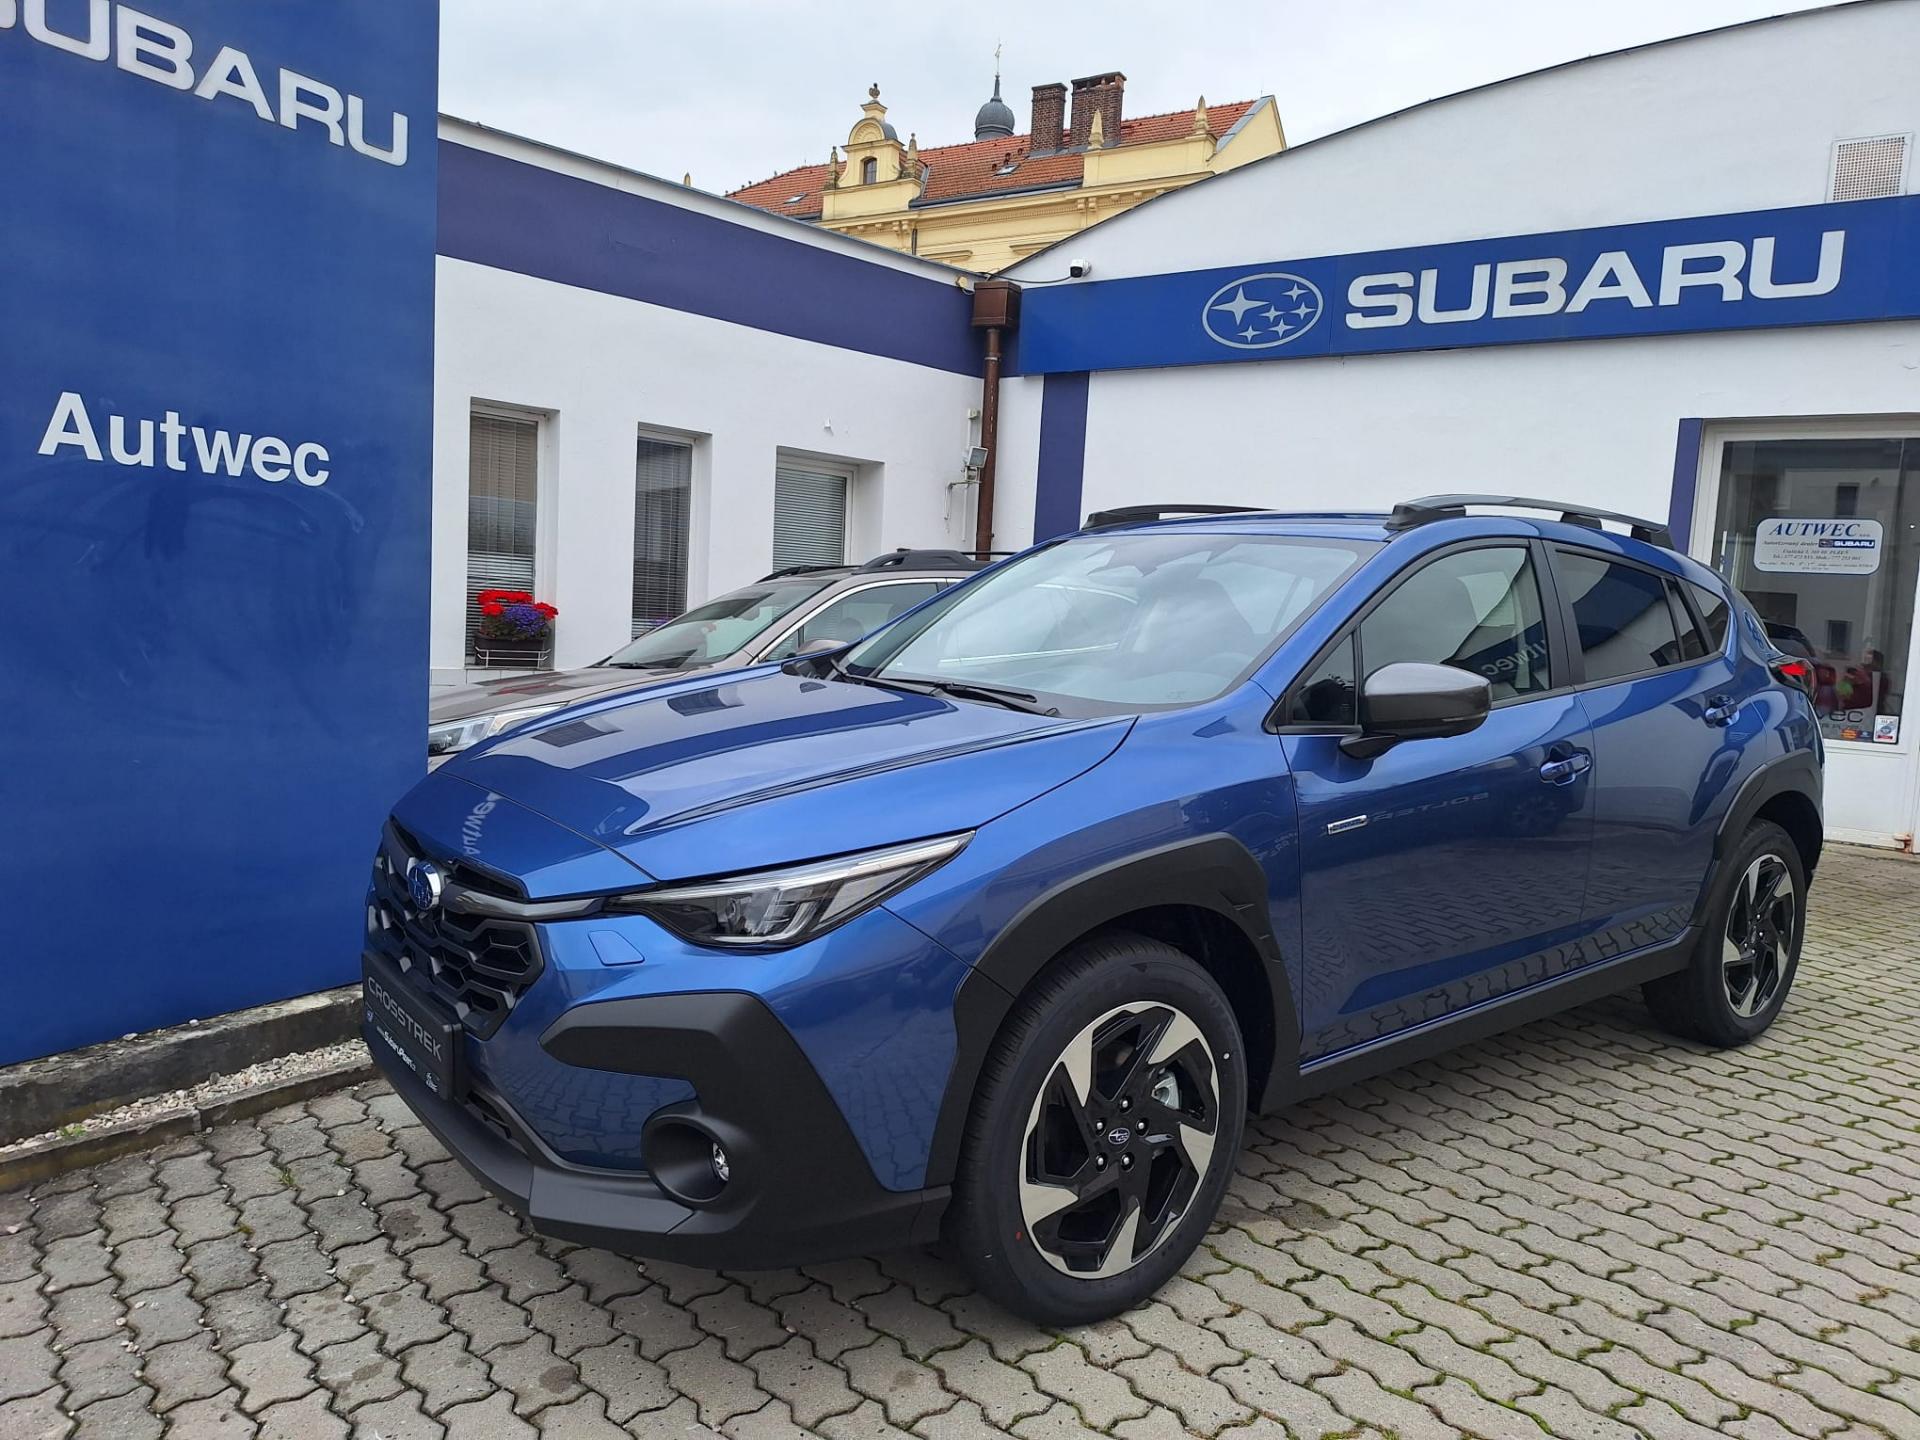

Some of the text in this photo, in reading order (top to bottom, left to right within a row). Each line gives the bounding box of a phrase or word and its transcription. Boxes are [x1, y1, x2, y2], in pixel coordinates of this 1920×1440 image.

[1345, 230, 1846, 331] SUBARU
[38, 391, 330, 486] Autwec
[1769, 522, 1861, 537] AUTWEC
[1833, 540, 1875, 548] SUBARU
[368, 976, 442, 1062] CROSSTREK
